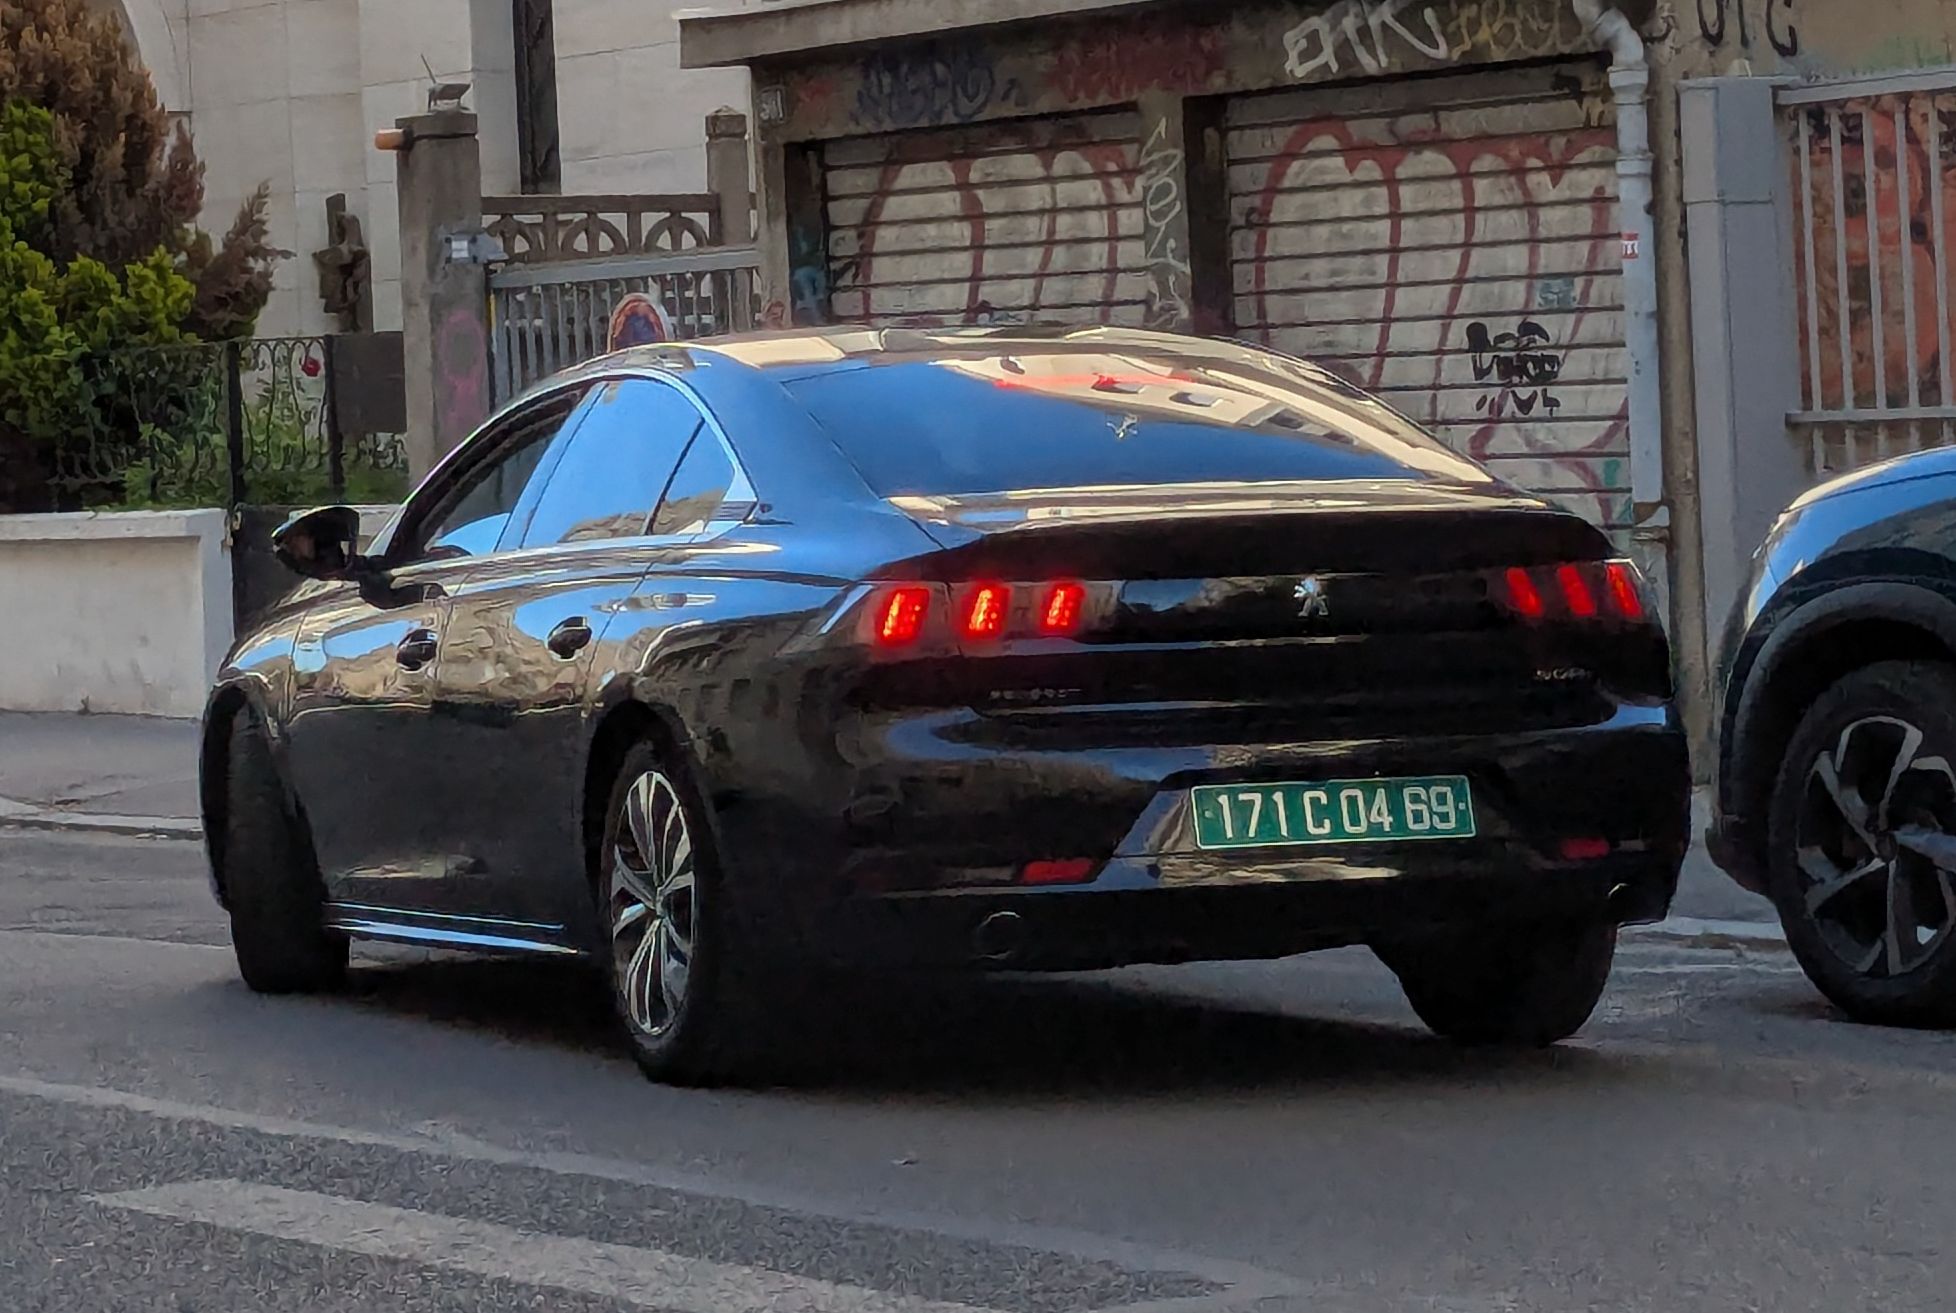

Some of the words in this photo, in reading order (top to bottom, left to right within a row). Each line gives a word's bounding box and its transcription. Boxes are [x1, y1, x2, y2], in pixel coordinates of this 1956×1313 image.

[1217, 791, 1288, 839] 171
[1302, 790, 1331, 835] C
[1340, 788, 1393, 833] 04
[1404, 786, 1456, 831] 69
